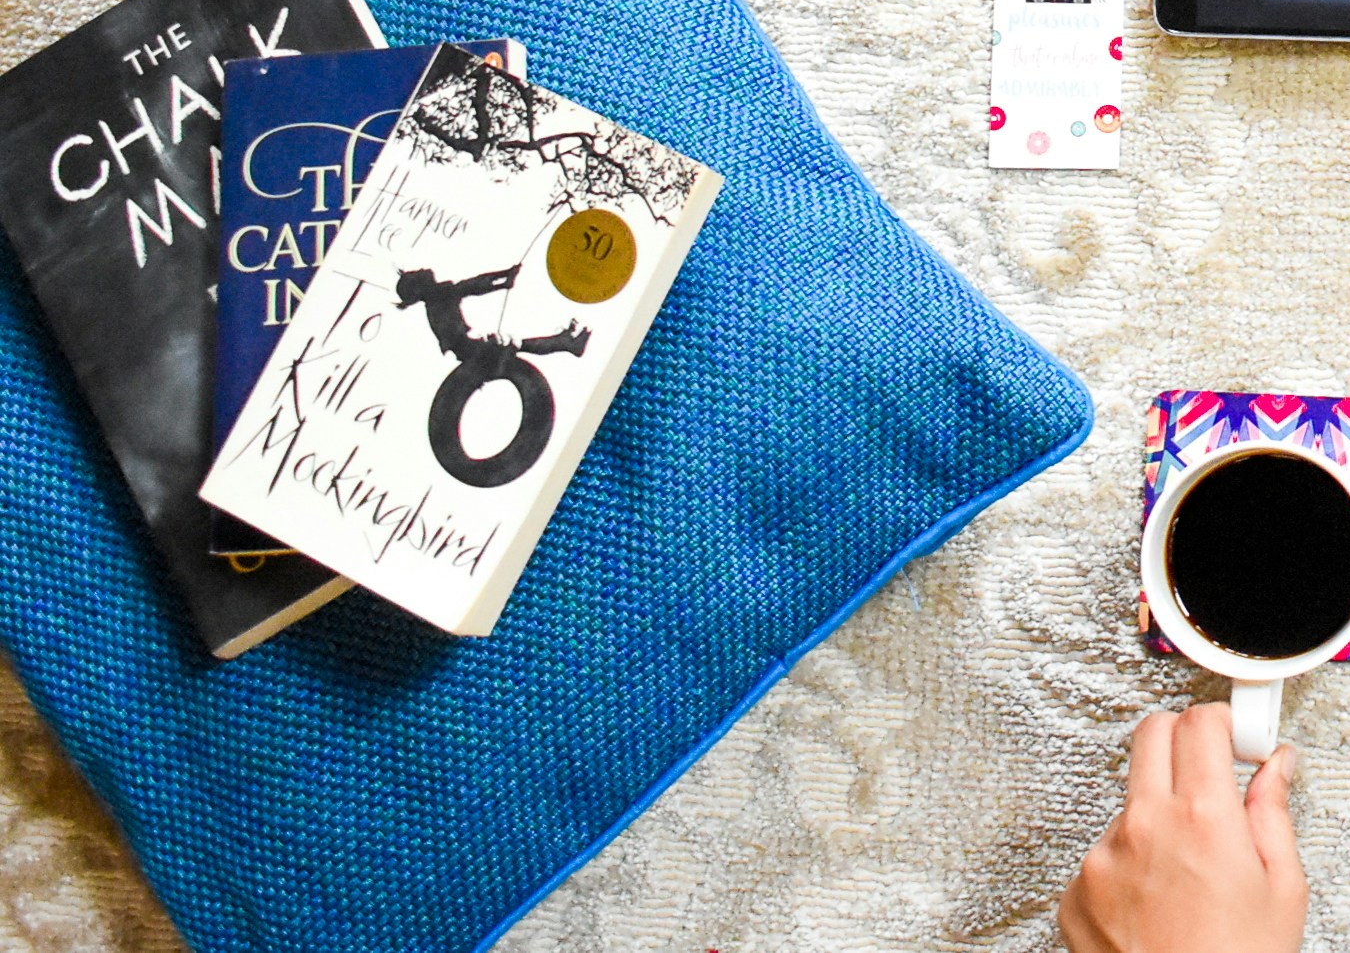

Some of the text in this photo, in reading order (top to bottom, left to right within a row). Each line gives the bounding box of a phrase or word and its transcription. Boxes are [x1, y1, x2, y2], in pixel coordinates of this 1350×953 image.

[122, 22, 193, 76] THE
[363, 164, 469, 248] Harper
[574, 225, 614, 261] 50
[331, 269, 390, 348] To
[271, 336, 389, 434] Kill a
[224, 404, 502, 577] Mockingbird
